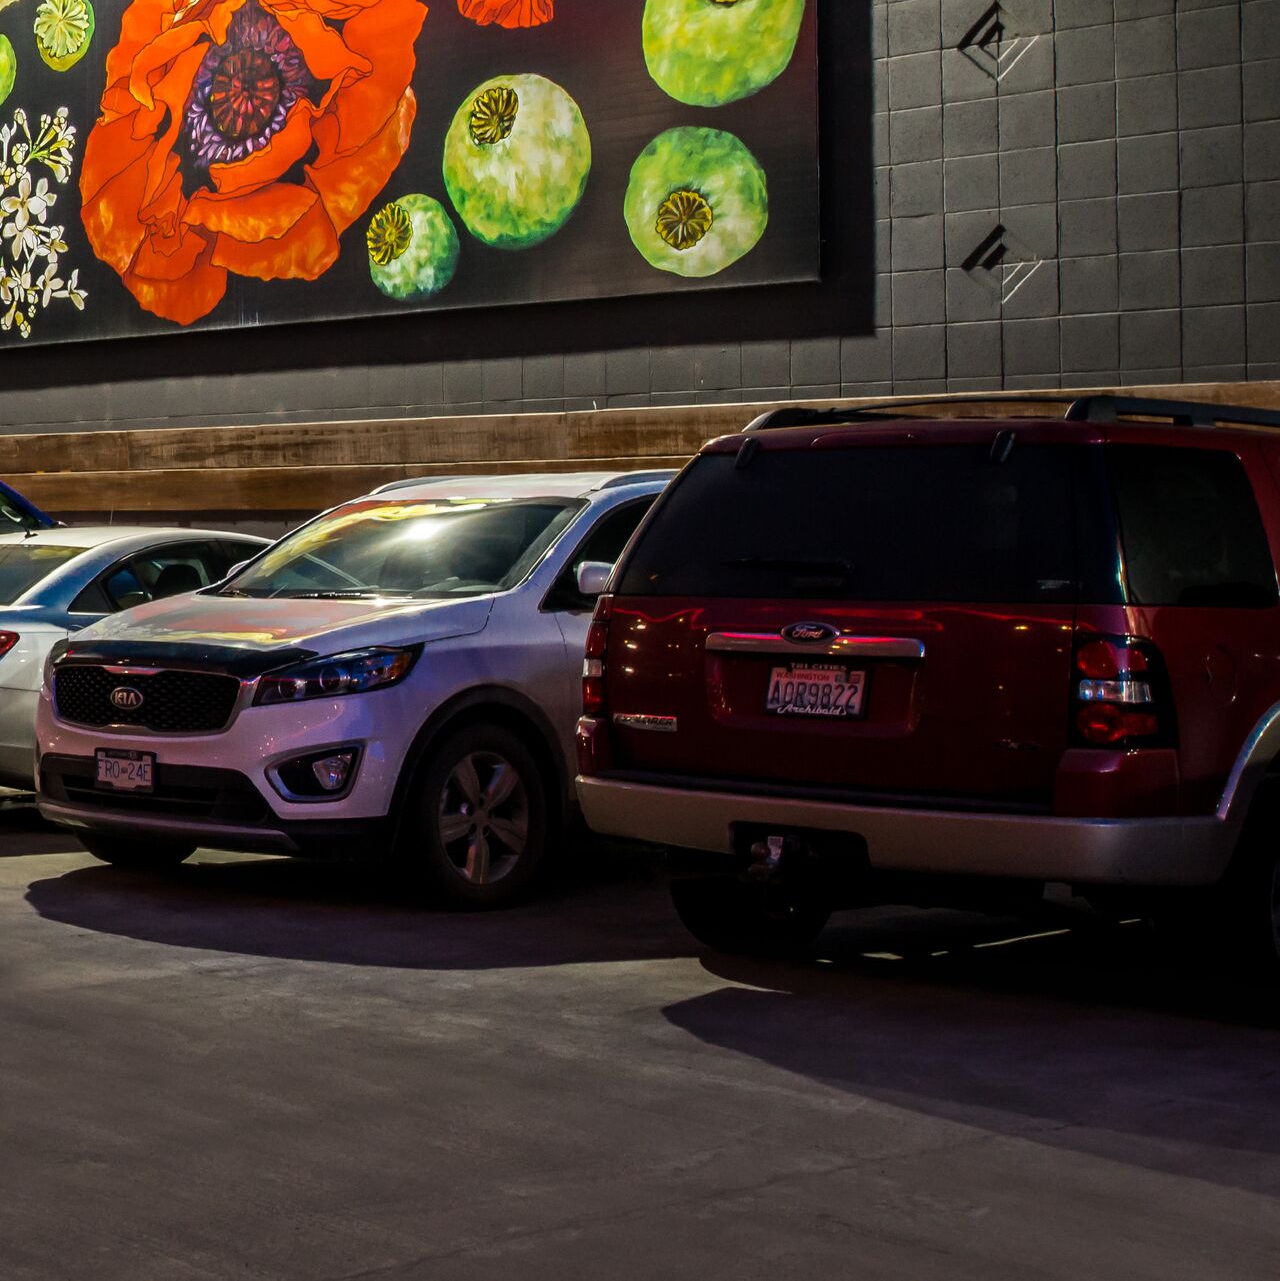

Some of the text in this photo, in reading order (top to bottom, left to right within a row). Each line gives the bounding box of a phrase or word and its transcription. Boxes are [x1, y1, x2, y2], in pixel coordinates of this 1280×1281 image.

[792, 625, 824, 639] Ford
[776, 670, 830, 682] WASHINGTON
[114, 691, 137, 705] KIA
